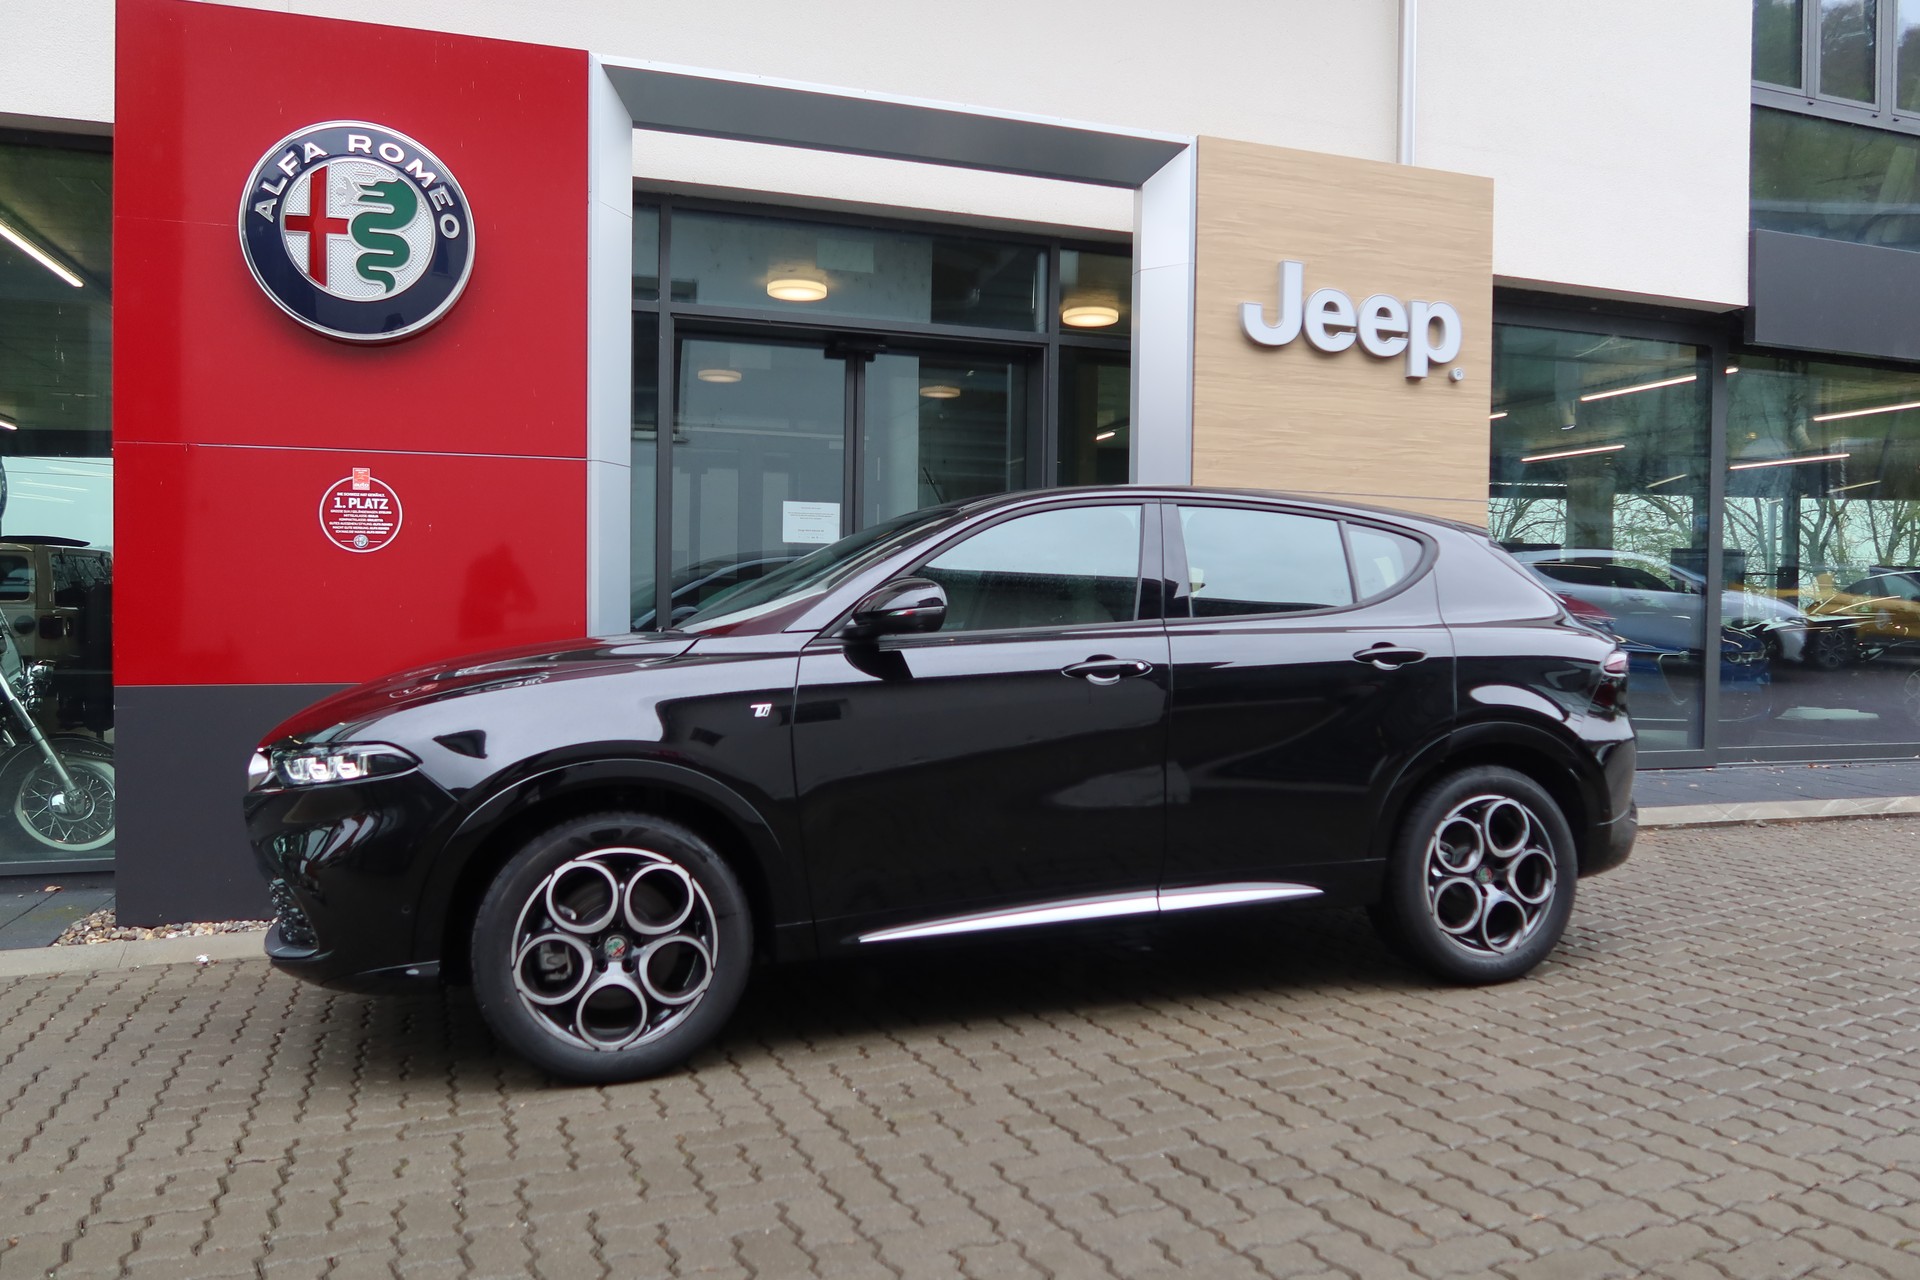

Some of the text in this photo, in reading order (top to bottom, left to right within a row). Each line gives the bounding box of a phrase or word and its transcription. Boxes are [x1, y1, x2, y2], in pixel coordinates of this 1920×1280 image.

[255, 134, 460, 239] ALFA ROMEO
[1238, 259, 1462, 379] Jeep
[334, 497, 388, 510] 1. PLATZ
